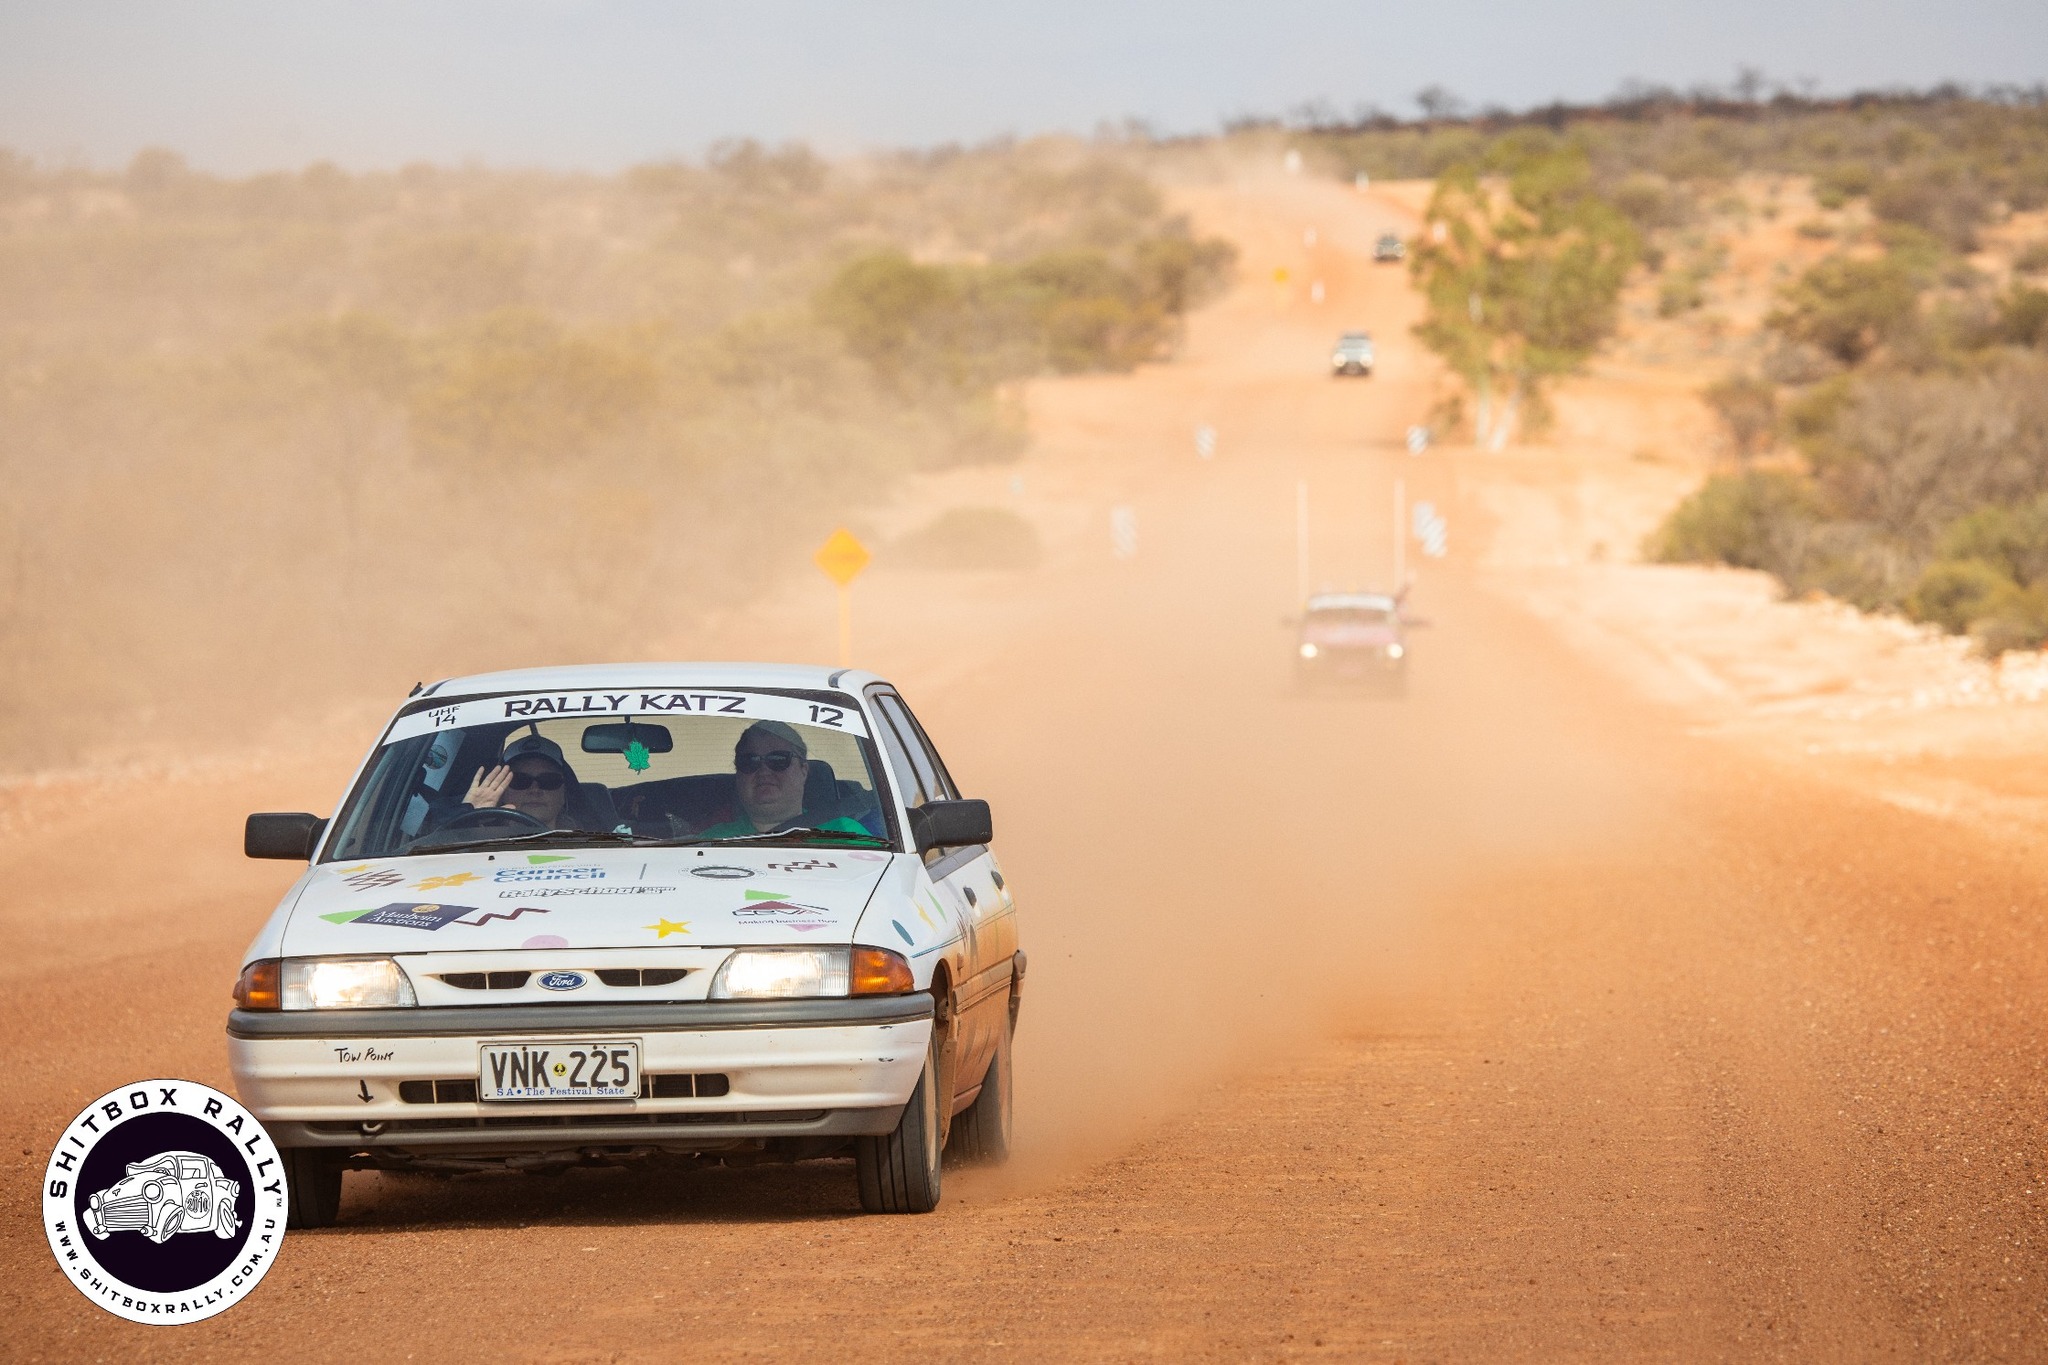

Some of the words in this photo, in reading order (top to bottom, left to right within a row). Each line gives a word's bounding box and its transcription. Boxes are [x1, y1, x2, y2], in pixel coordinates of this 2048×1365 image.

[428, 705, 460, 718] UHF
[504, 694, 630, 717] RALLY
[639, 693, 747, 714] KATZ
[435, 713, 456, 727] 14
[808, 704, 844, 727] 12
[494, 872, 606, 883] Council
[549, 974, 576, 987] Ford
[489, 1050, 551, 1089] VNK
[568, 1049, 630, 1088] 225
[525, 1087, 545, 1096] The
[549, 1086, 592, 1096] Festival
[596, 1085, 625, 1095] State
